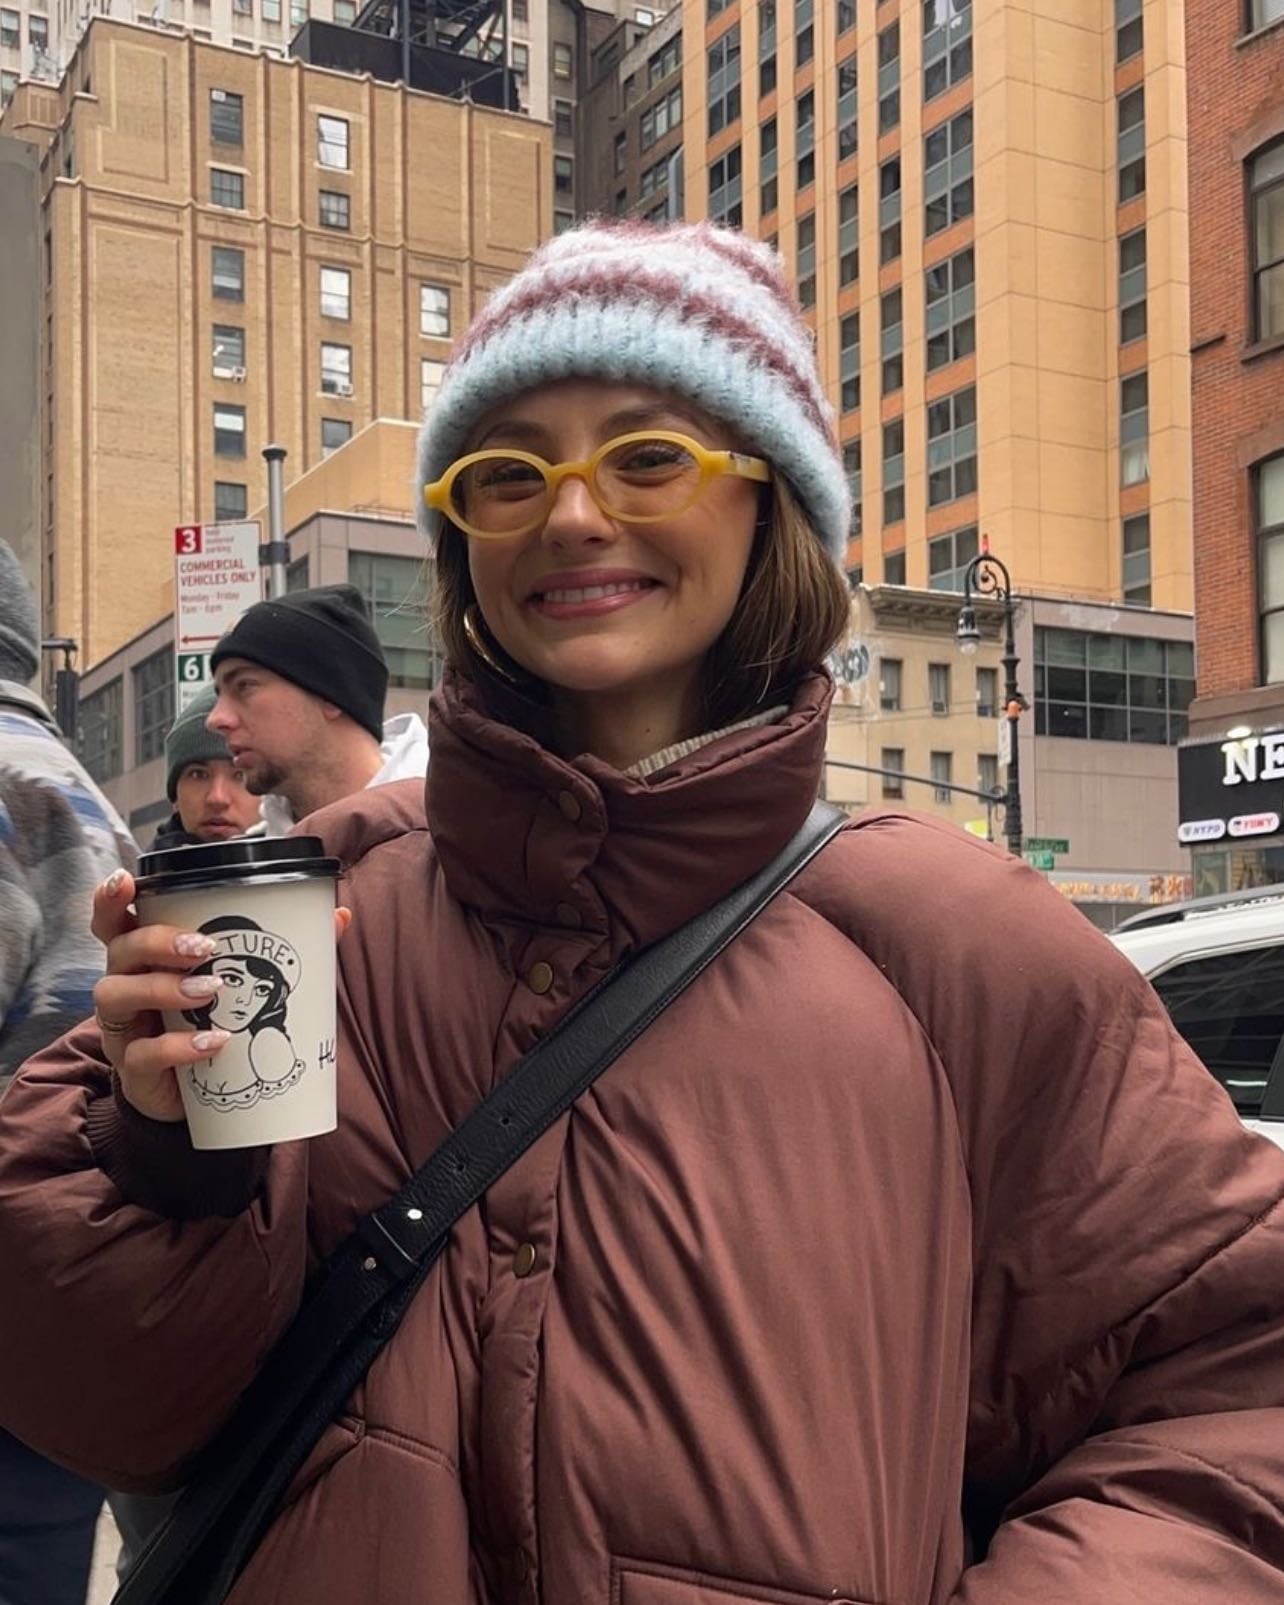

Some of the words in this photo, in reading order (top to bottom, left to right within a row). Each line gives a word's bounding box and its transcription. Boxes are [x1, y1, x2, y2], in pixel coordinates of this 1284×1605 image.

[181, 529, 197, 553] 3
[180, 558, 245, 573] COMMERCIAL
[181, 573, 228, 587] VEHICLES
[230, 571, 256, 584] ONLY
[181, 593, 209, 602] Monday
[217, 591, 240, 601] Friday
[184, 656, 200, 681] 6
[1221, 733, 1284, 786] NE
[1193, 824, 1221, 835] NYPD
